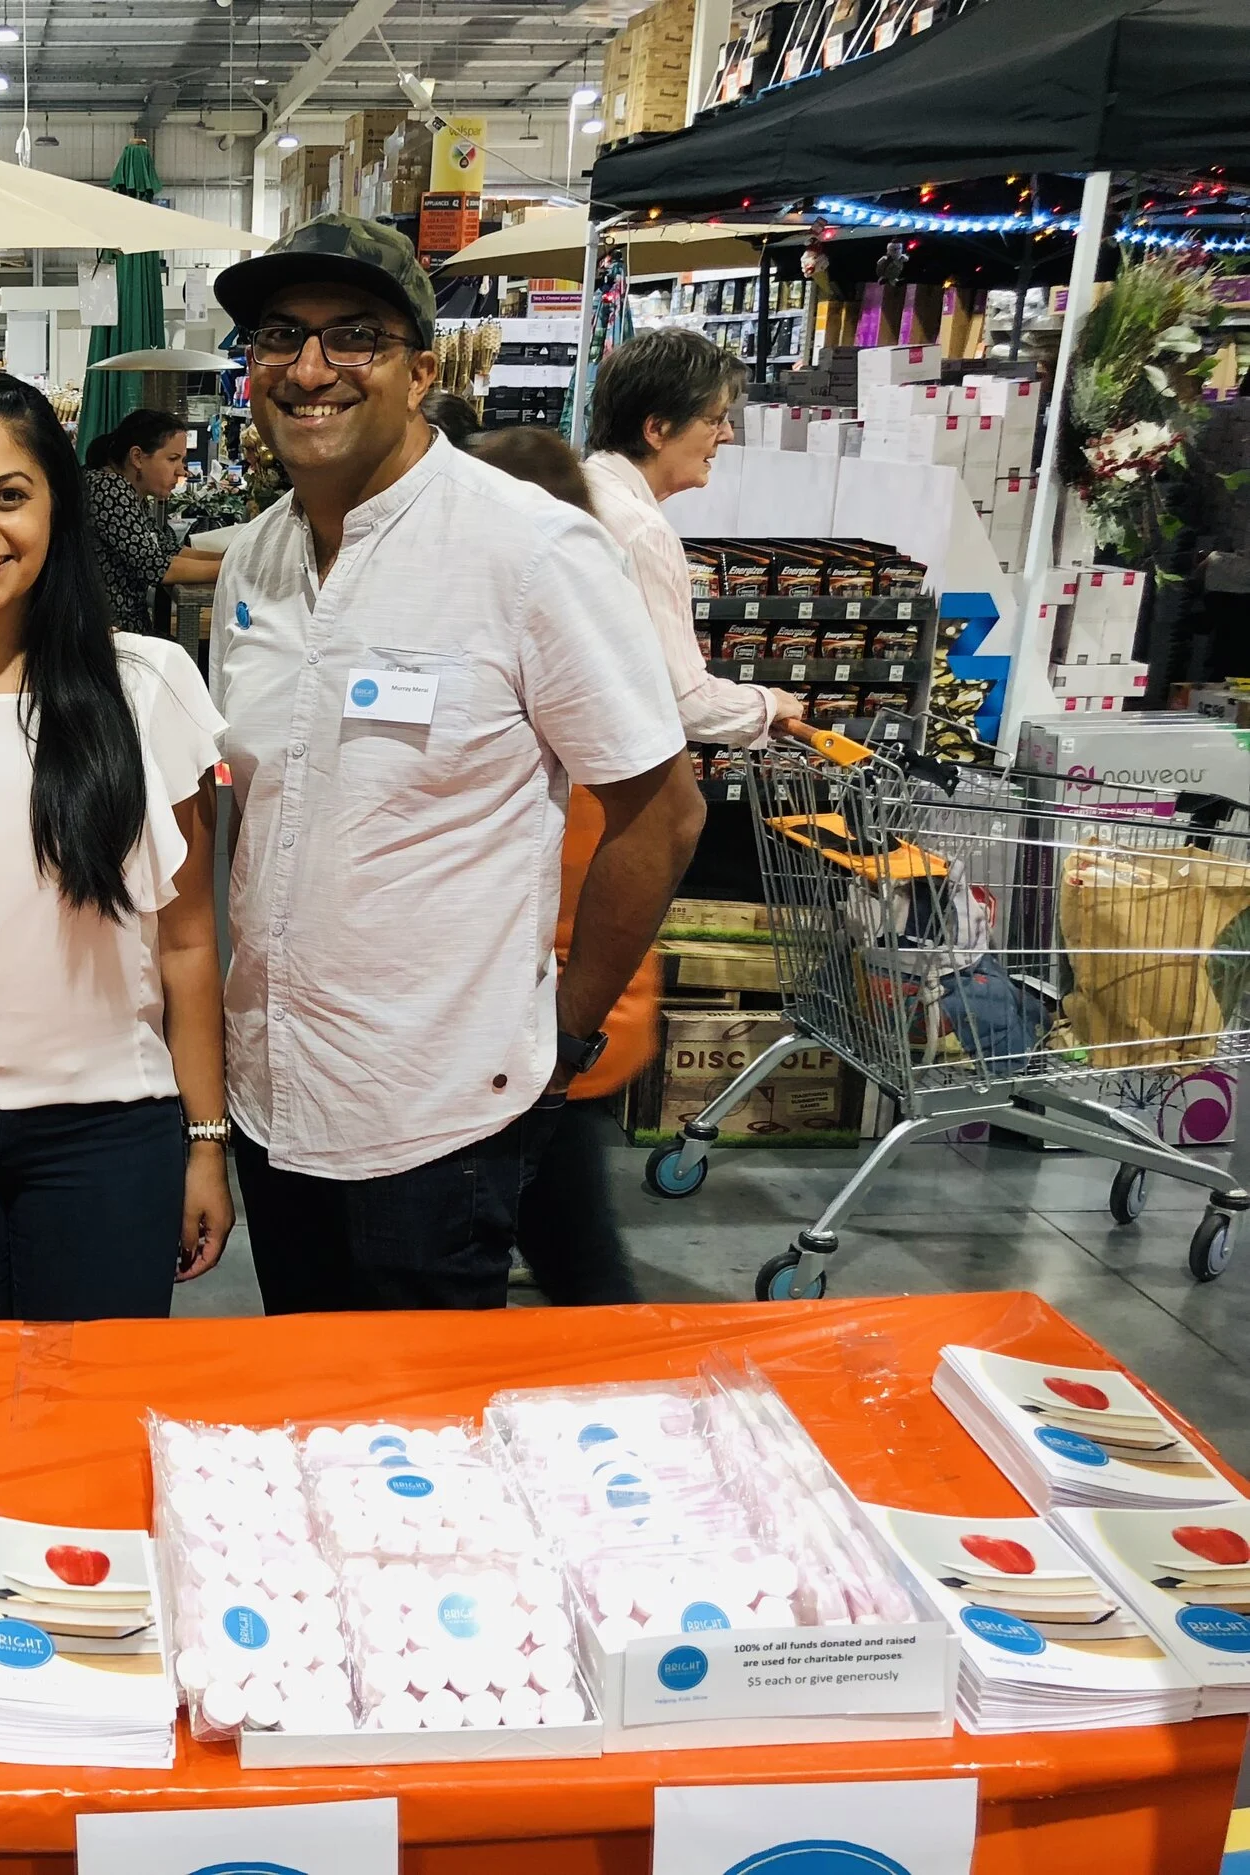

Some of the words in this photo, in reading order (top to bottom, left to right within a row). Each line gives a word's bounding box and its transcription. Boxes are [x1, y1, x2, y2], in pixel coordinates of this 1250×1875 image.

[449, 124, 482, 137] valspar
[728, 565, 767, 577] Energizer
[781, 565, 820, 577] Energizer
[832, 568, 860, 577] Energizer
[883, 566, 911, 576] Energizer
[729, 624, 767, 635] Energizer
[778, 626, 816, 636] Energizer
[823, 631, 852, 640] Energizer
[878, 630, 905, 639] Energizer
[817, 692, 844, 701] Energizer
[1102, 768, 1203, 785] nouveau
[677, 1051, 746, 1069] DISC
[778, 1050, 834, 1070] OLF
[392, 1481, 427, 1490] BRIGHT
[444, 1608, 476, 1620] BRIG
[240, 1611, 250, 1644] BRIGHT
[970, 1618, 1028, 1637] BRIGHT
[1187, 1620, 1248, 1633] BRIGHT
[734, 1644, 760, 1653] 100%
[762, 1642, 773, 1651] of
[775, 1641, 787, 1650] all
[789, 1640, 818, 1650] funds
[820, 1637, 862, 1648] donated
[864, 1637, 883, 1647] and
[885, 1635, 916, 1645] raised
[742, 1659, 759, 1668] are
[761, 1656, 784, 1666] used
[787, 1656, 802, 1665] for
[803, 1652, 853, 1665] charitable
[664, 1661, 701, 1674] BRIGHT
[747, 1675, 761, 1687] $5
[764, 1673, 792, 1686] each
[795, 1676, 806, 1685] or
[809, 1671, 833, 1685] give
[835, 1670, 899, 1684] generously
